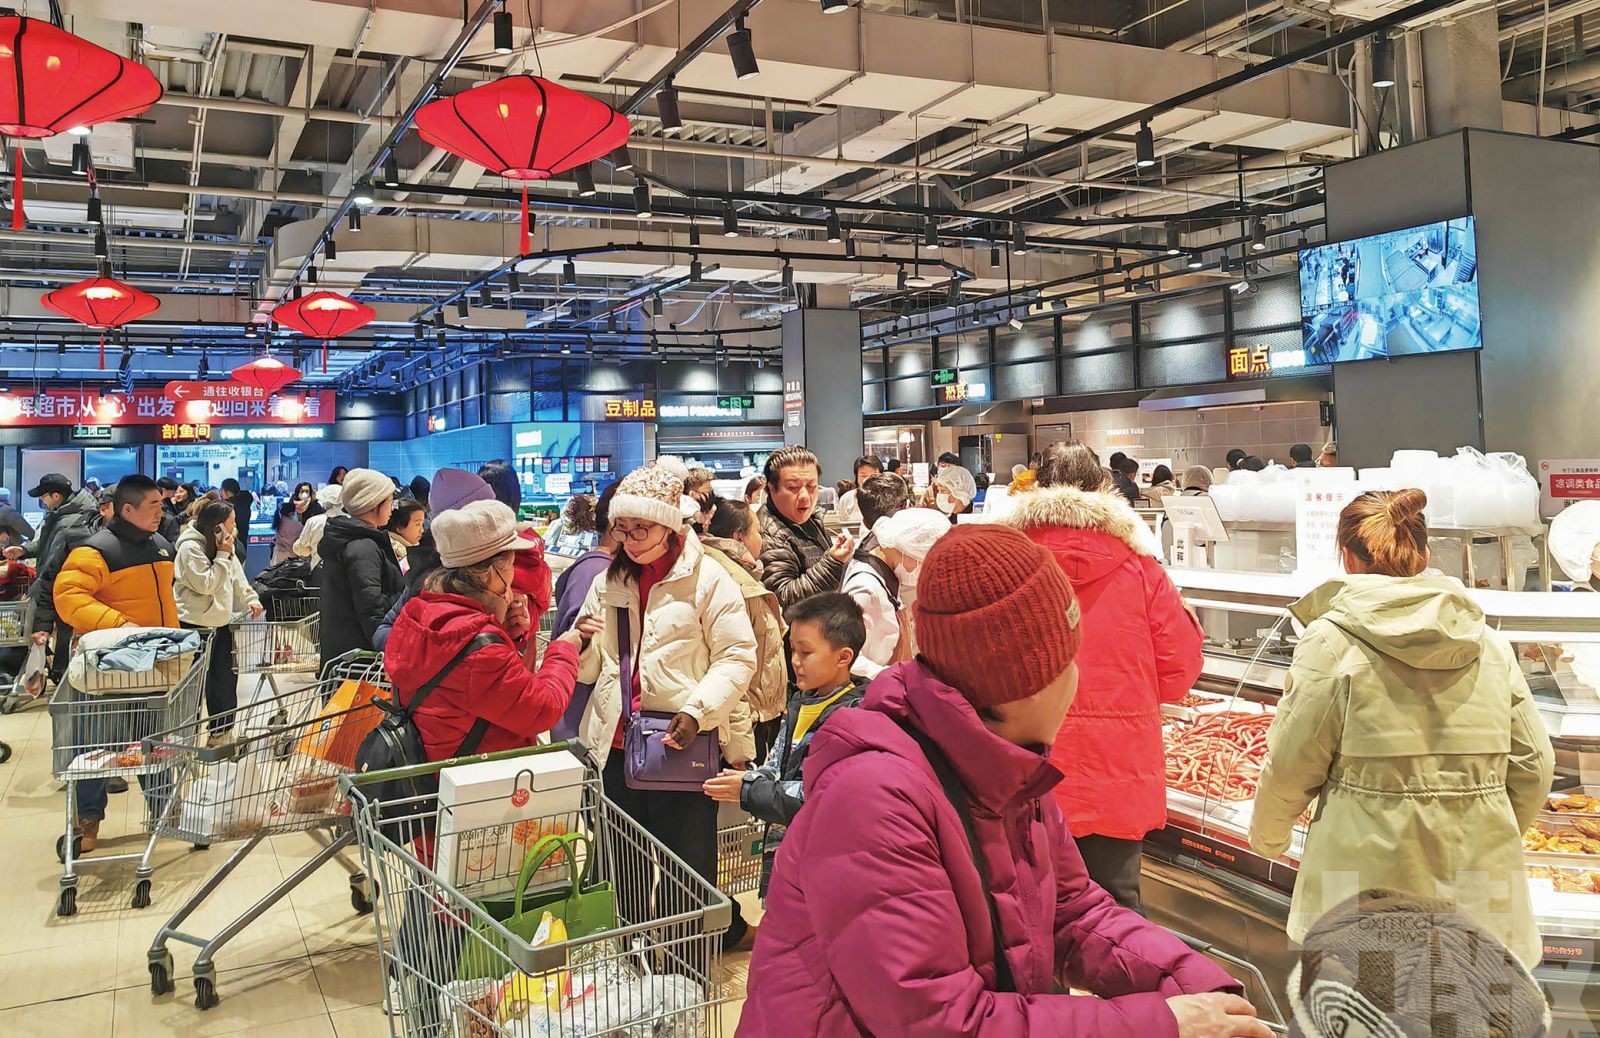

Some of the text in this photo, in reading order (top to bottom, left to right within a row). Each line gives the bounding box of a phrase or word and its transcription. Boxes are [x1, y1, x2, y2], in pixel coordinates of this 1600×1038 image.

[1229, 344, 1270, 374] 面点
[203, 386, 264, 397] 通往收银台
[606, 399, 656, 417] 豆制品
[162, 424, 211, 439] 剖鱼间
